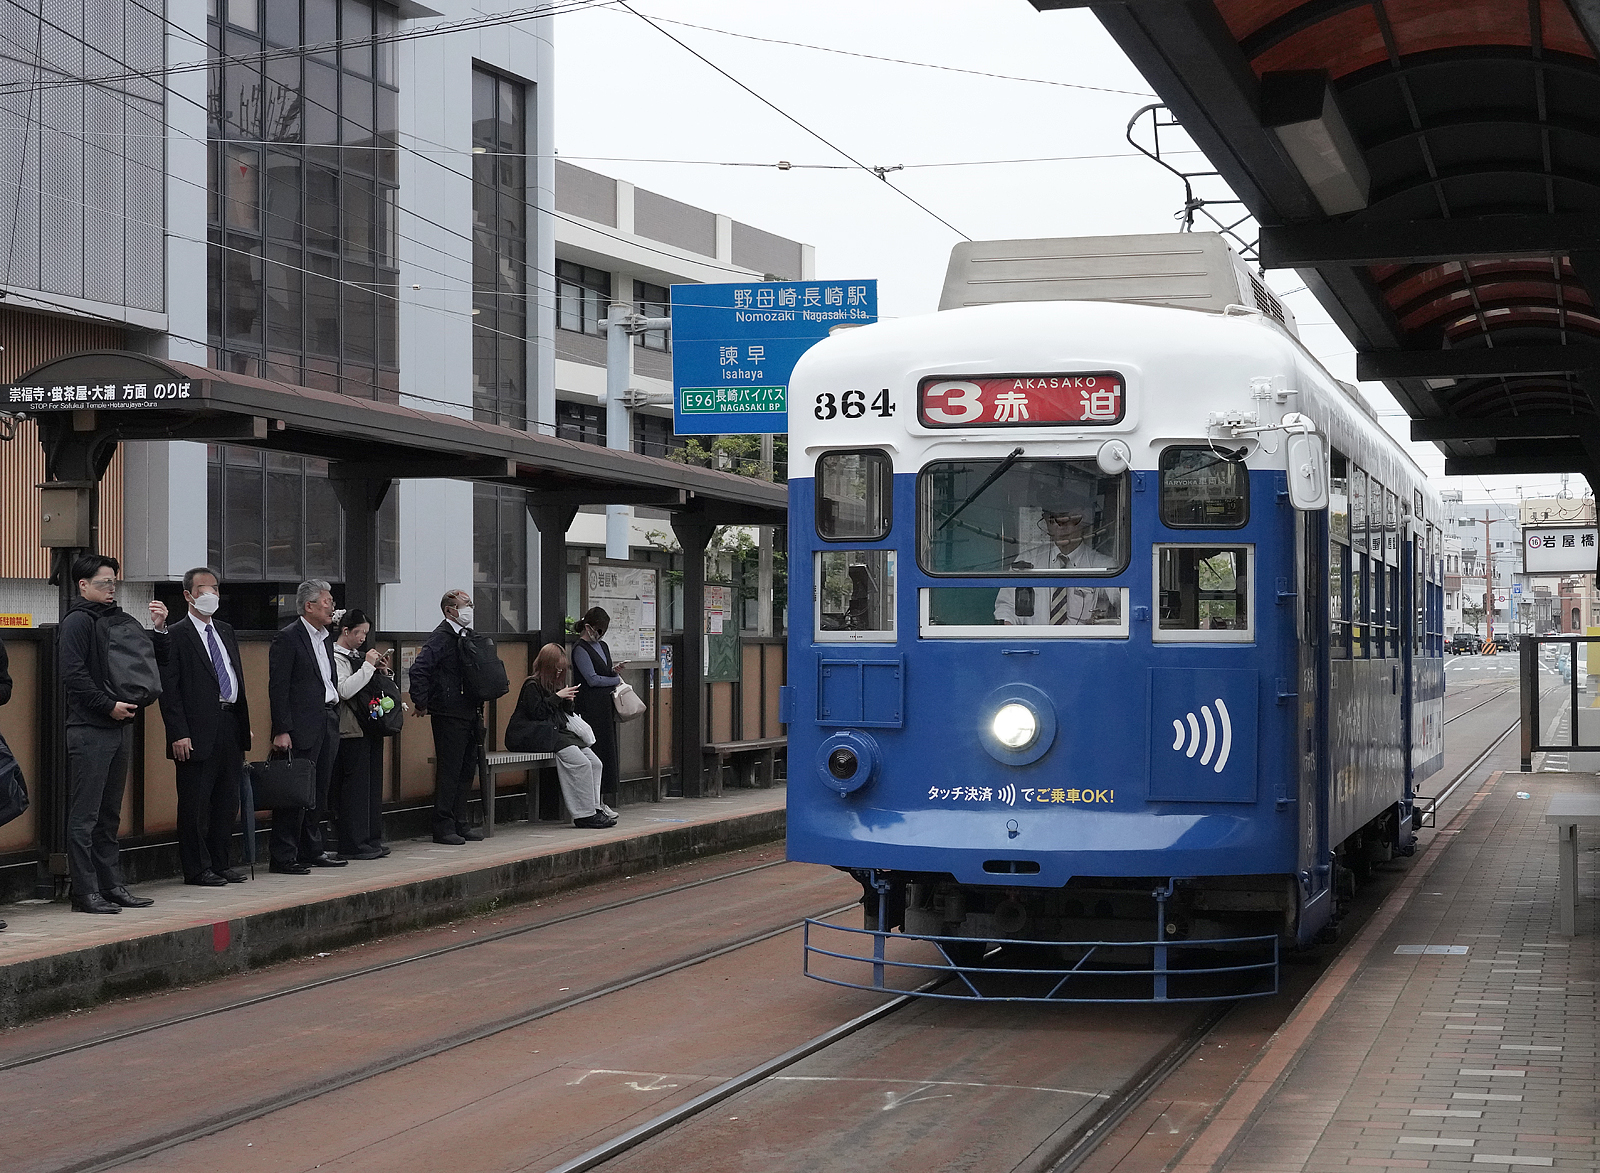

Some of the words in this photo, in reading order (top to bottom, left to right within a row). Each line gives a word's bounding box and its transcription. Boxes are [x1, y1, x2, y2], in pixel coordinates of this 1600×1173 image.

[735, 310, 795, 322] Nomozaki
[803, 309, 847, 322] Nagasaki
[850, 308, 870, 320] Sta.
[719, 345, 766, 366] 諫早
[722, 368, 764, 381] Isahaya
[1013, 376, 1097, 390] AKASAKO
[122, 383, 147, 400] 方面
[153, 383, 191, 399] のりば
[686, 394, 712, 407] E96
[715, 388, 785, 403] 長崎バイパス
[720, 403, 766, 412] NAGASAKI
[768, 402, 781, 411] BP
[814, 388, 896, 420] 364
[925, 381, 984, 424] 3
[993, 390, 1116, 422] 赤迫
[1542, 533, 1595, 549] 岩屋橋
[928, 785, 993, 802] タッチ決済
